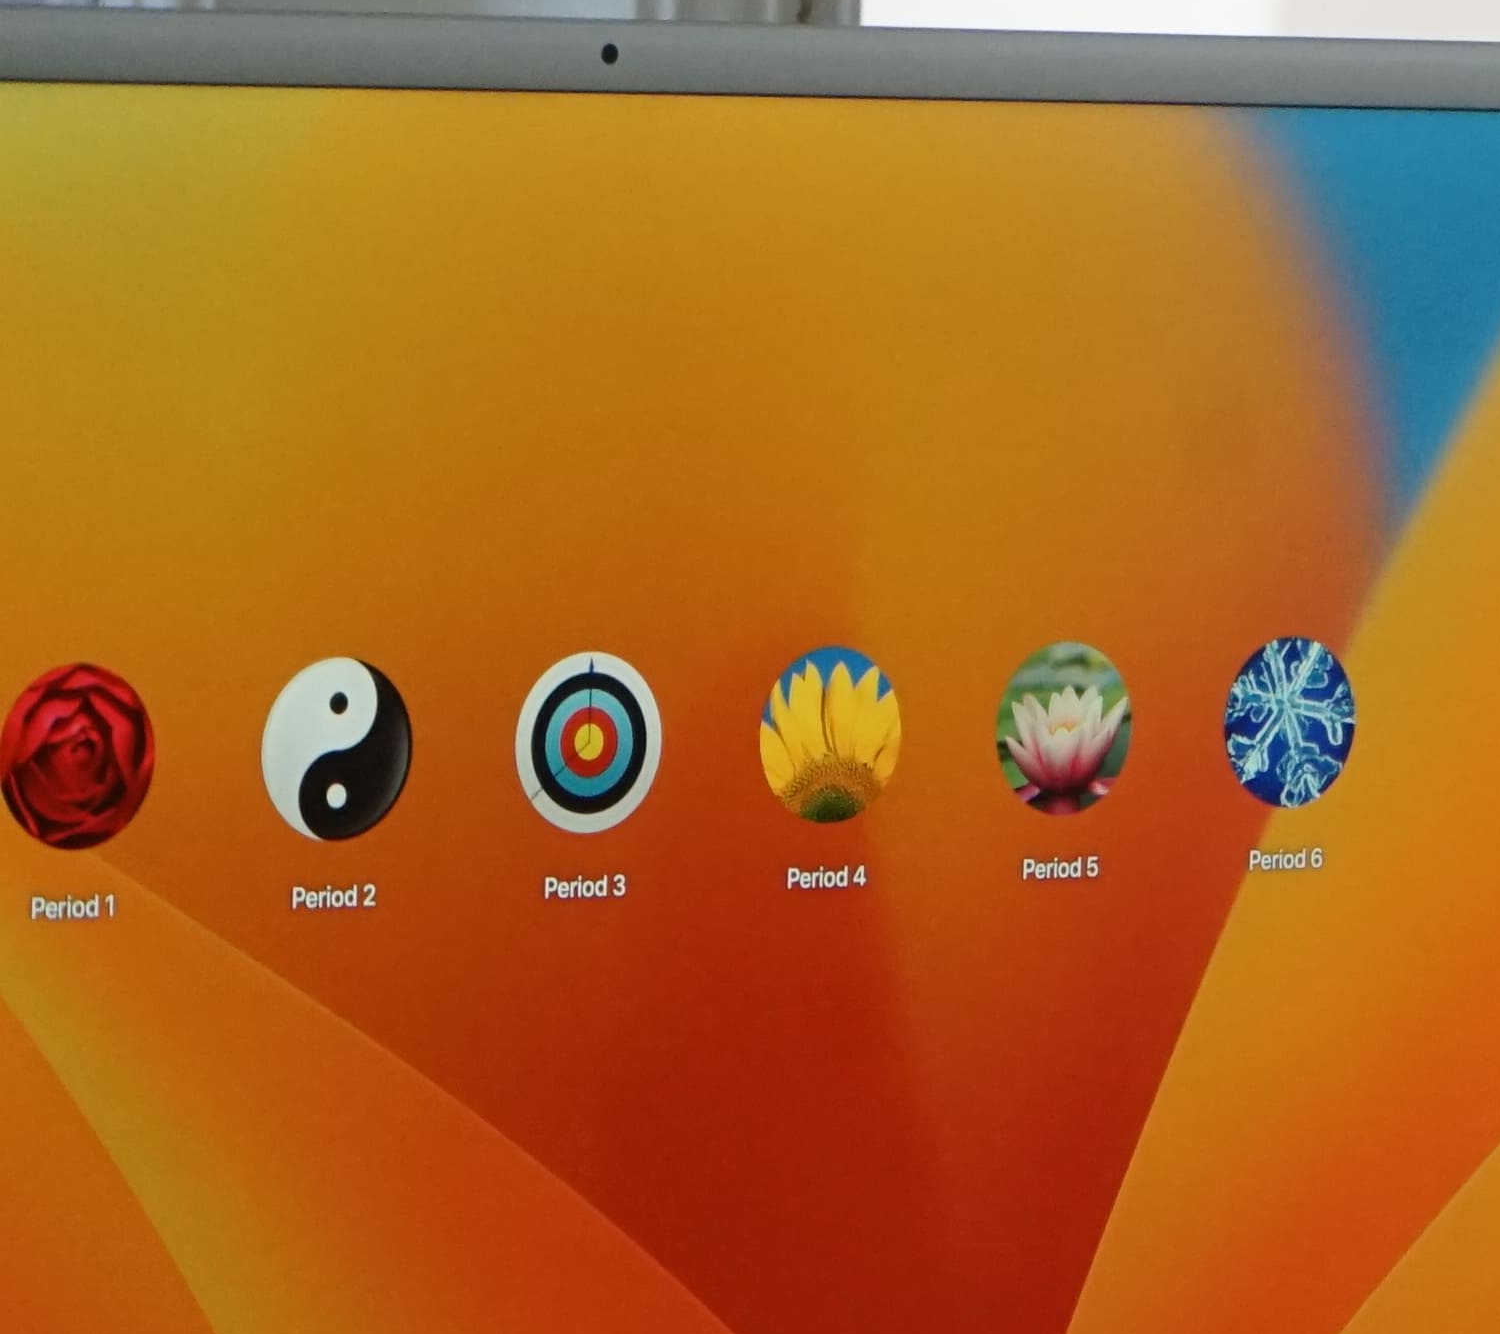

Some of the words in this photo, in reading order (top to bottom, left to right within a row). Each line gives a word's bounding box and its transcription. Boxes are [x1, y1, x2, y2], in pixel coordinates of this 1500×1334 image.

[1023, 858, 1081, 880] Period
[1086, 857, 1099, 878] 5
[1249, 850, 1306, 871] Period
[1311, 848, 1323, 869] 6
[544, 876, 607, 899] Period
[612, 874, 626, 897] 3
[787, 867, 846, 890] Period
[851, 866, 866, 887] 4
[31, 895, 99, 921] Period
[104, 894, 116, 918] 1
[292, 886, 357, 910] Period
[360, 884, 376, 908] 2
